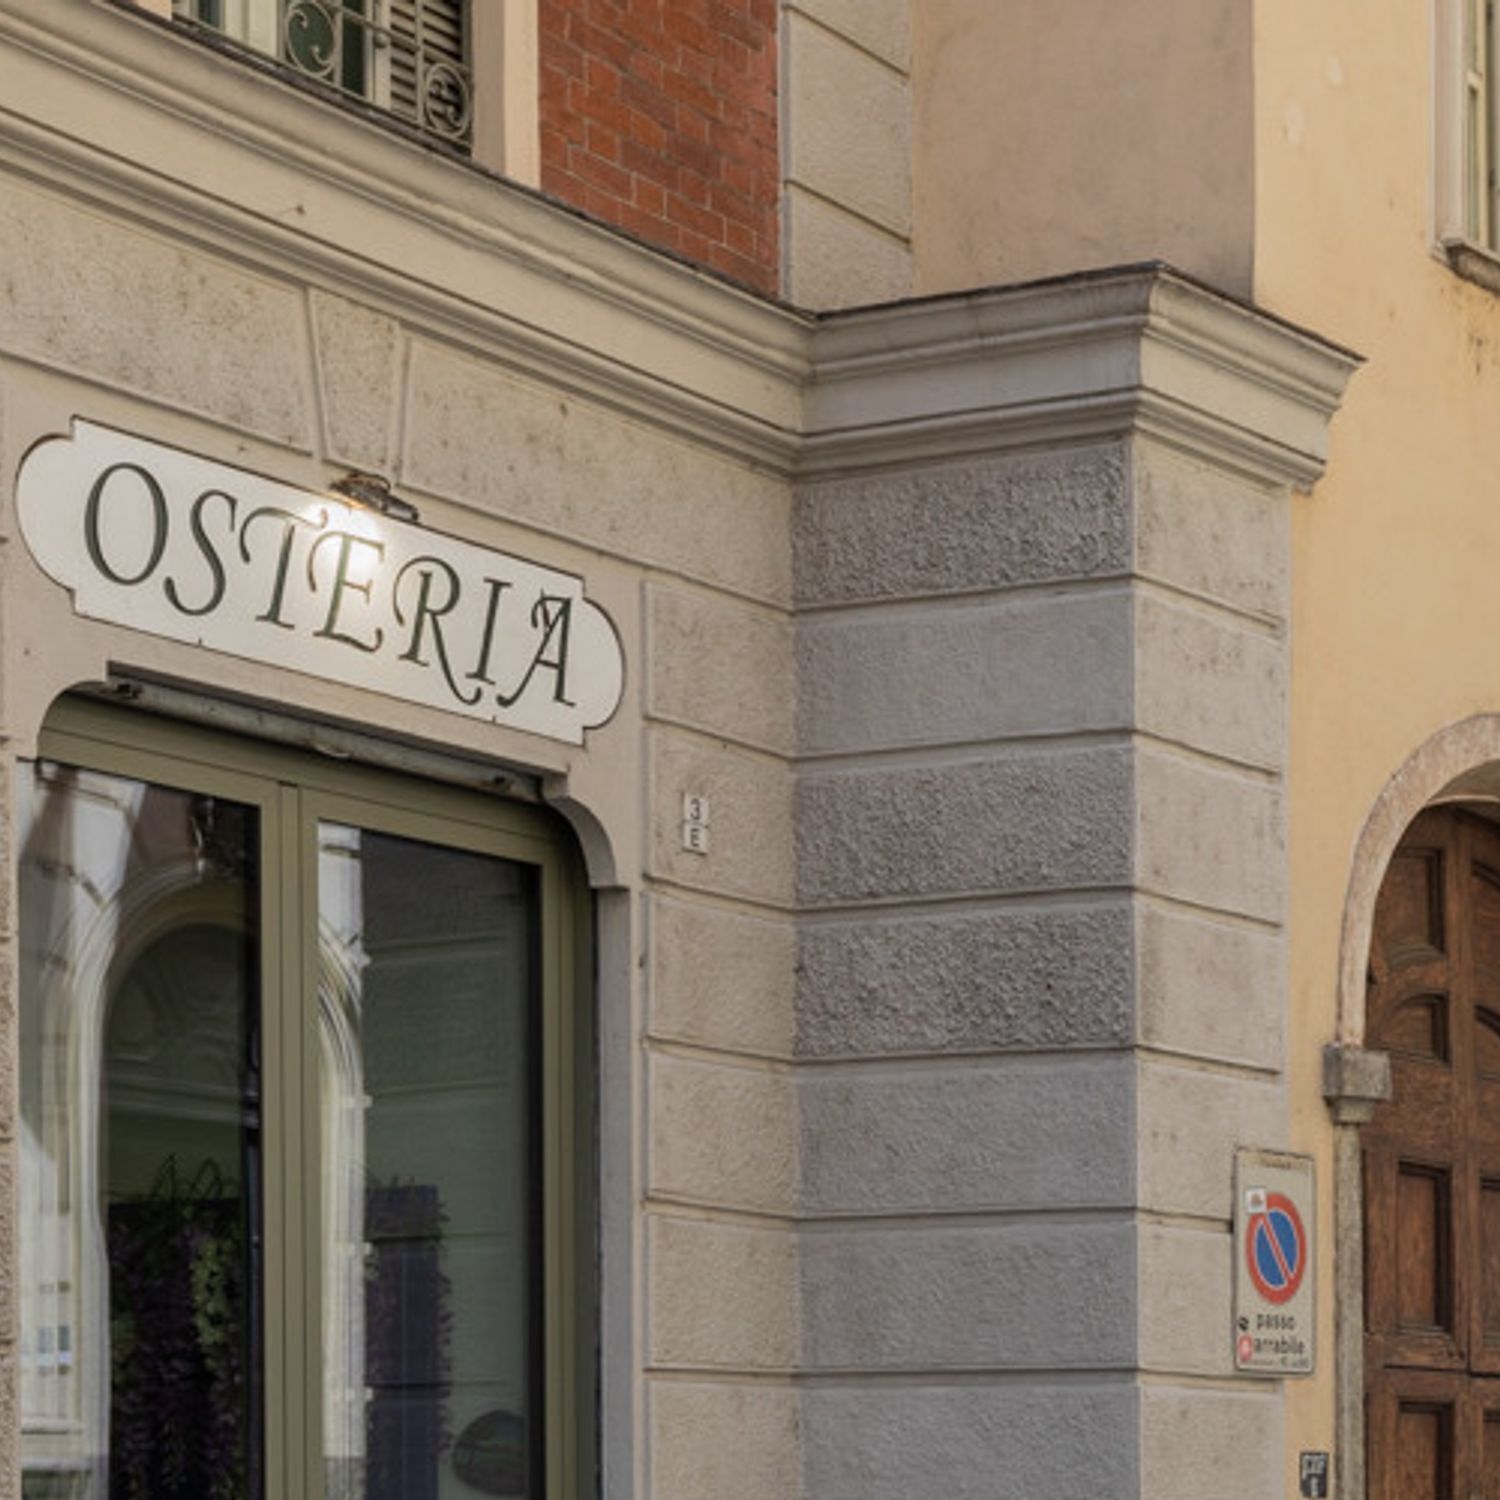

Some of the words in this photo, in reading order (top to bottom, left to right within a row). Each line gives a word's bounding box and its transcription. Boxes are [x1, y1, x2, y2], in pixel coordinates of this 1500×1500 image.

[84, 461, 577, 708] OSTERIA
[689, 797, 701, 821] 3
[1256, 1313, 1296, 1331] passo
[1253, 1335, 1305, 1355] arrabile
